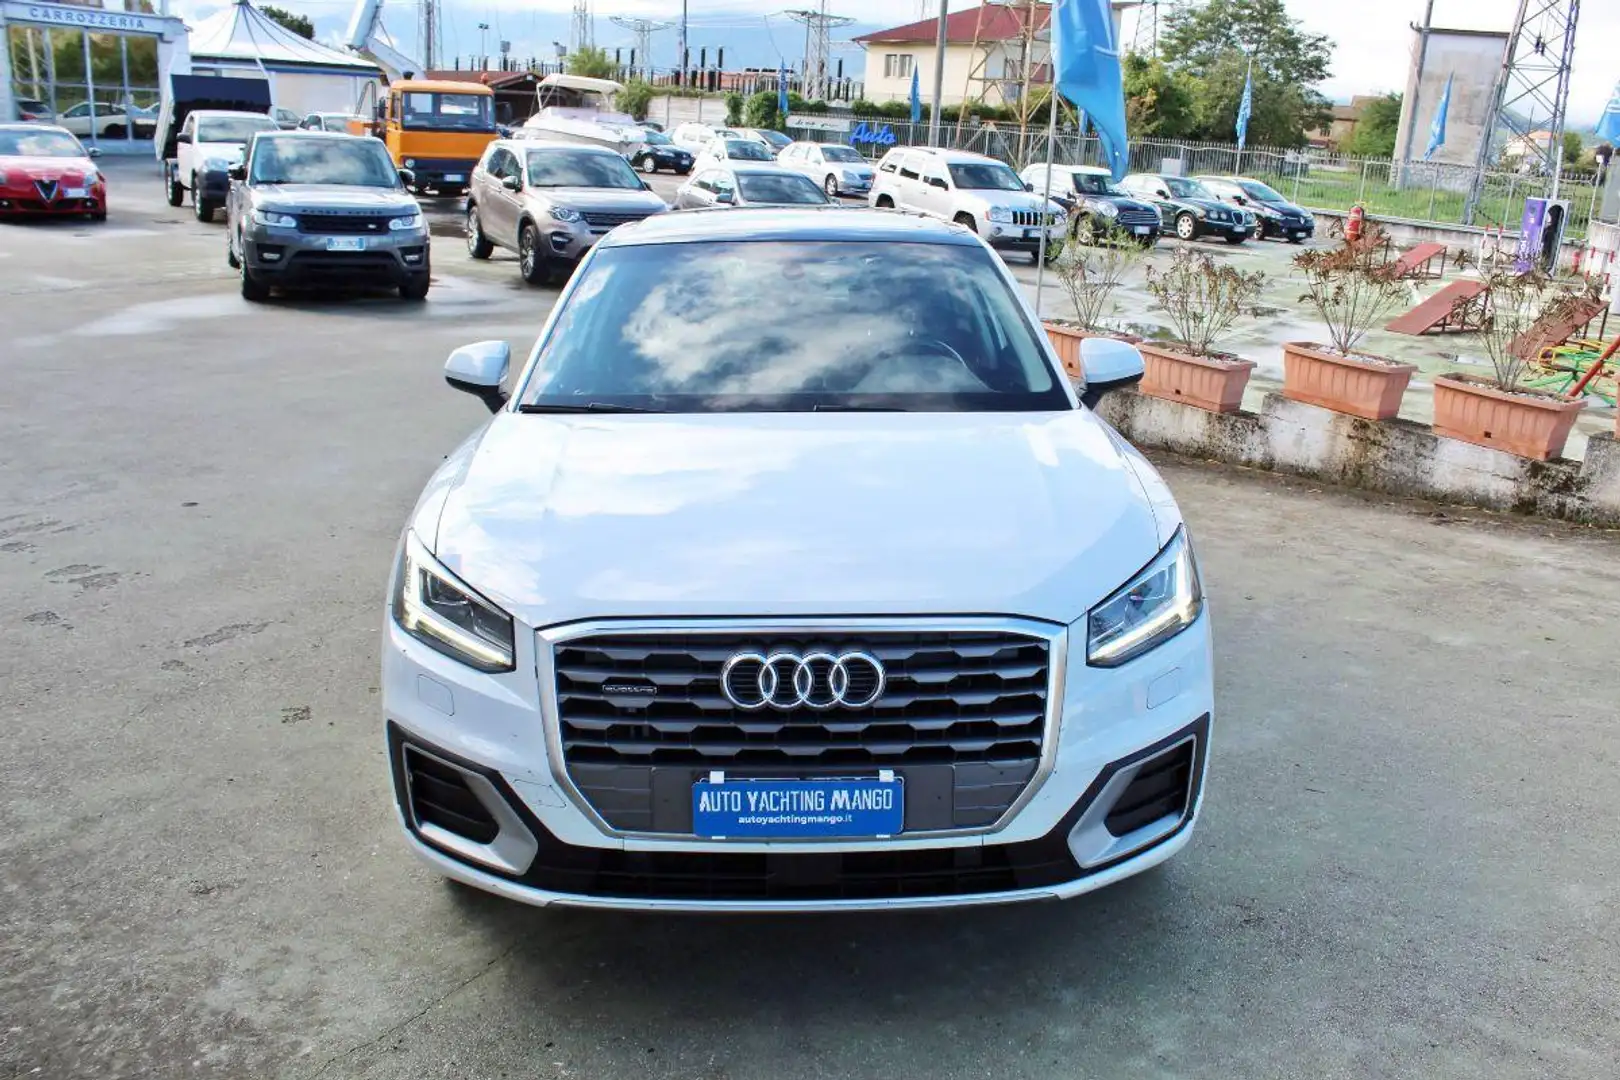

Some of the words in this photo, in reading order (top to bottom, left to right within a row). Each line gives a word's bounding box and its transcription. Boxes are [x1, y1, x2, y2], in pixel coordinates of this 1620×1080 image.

[29, 7, 145, 29] CARROZZERIA
[848, 121, 897, 145] Auto
[699, 791, 741, 812] AUTO
[747, 790, 825, 811] YACHTING
[830, 789, 893, 810] MANGO
[738, 813, 852, 825] autoyachtingmango.it
